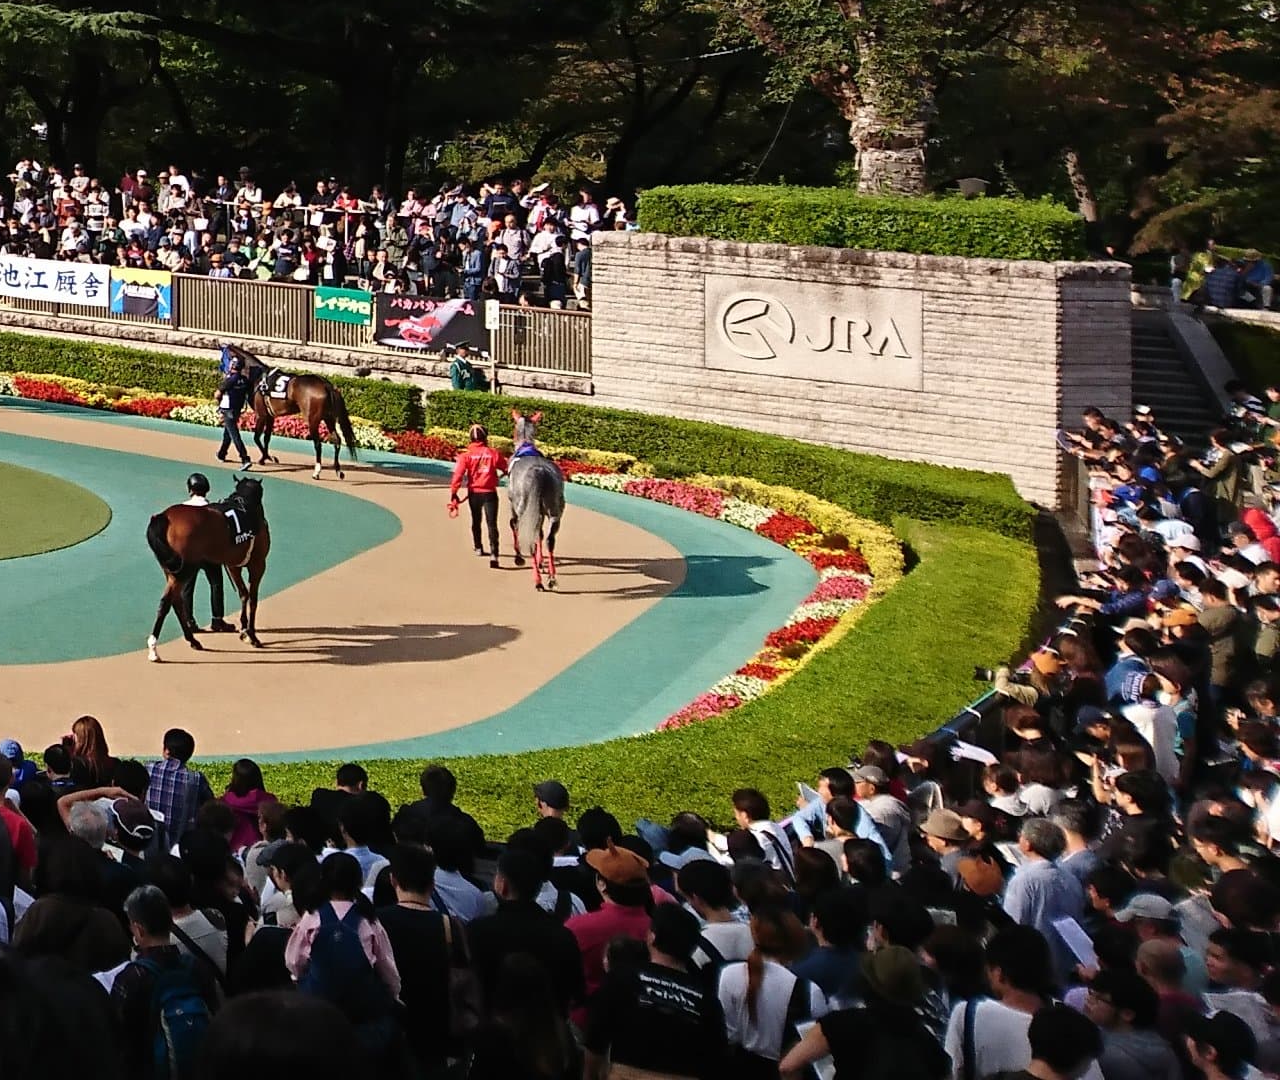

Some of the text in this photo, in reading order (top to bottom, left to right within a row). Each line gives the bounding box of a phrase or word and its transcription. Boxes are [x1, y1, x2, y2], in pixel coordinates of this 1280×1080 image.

[315, 295, 371, 315] レイデオロ
[806, 315, 912, 360] JRA
[274, 375, 290, 392] 5
[225, 509, 241, 534] 7
